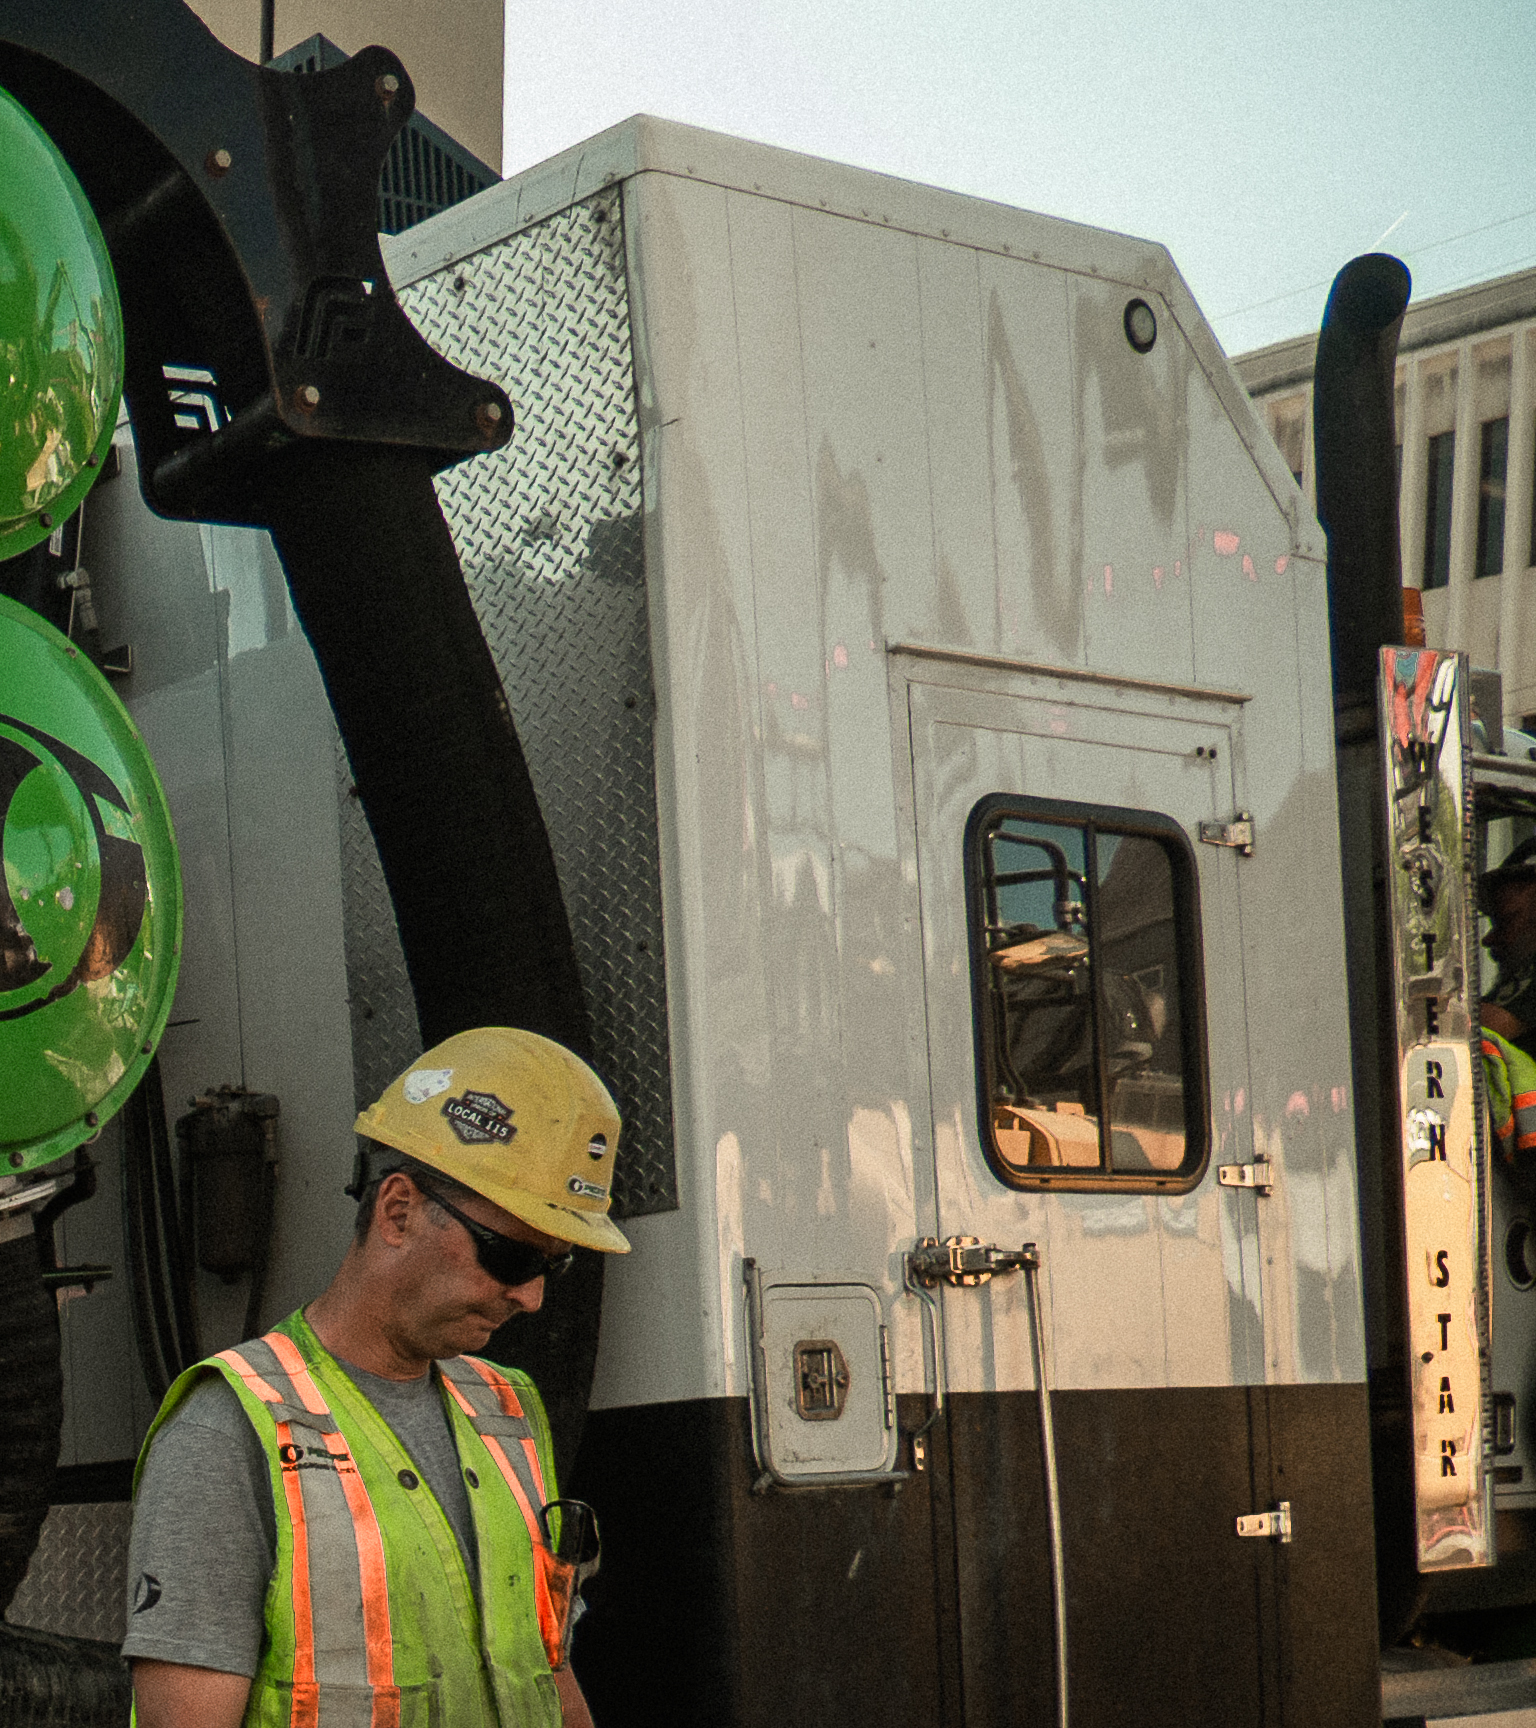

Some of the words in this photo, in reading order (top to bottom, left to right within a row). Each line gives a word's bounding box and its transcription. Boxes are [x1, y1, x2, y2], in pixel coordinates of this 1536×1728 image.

[447, 1102, 482, 1126] LOCAL
[485, 1120, 509, 1138] 115
[1408, 740, 1447, 1162] WESTERN
[1436, 1250, 1457, 1477] STAR
